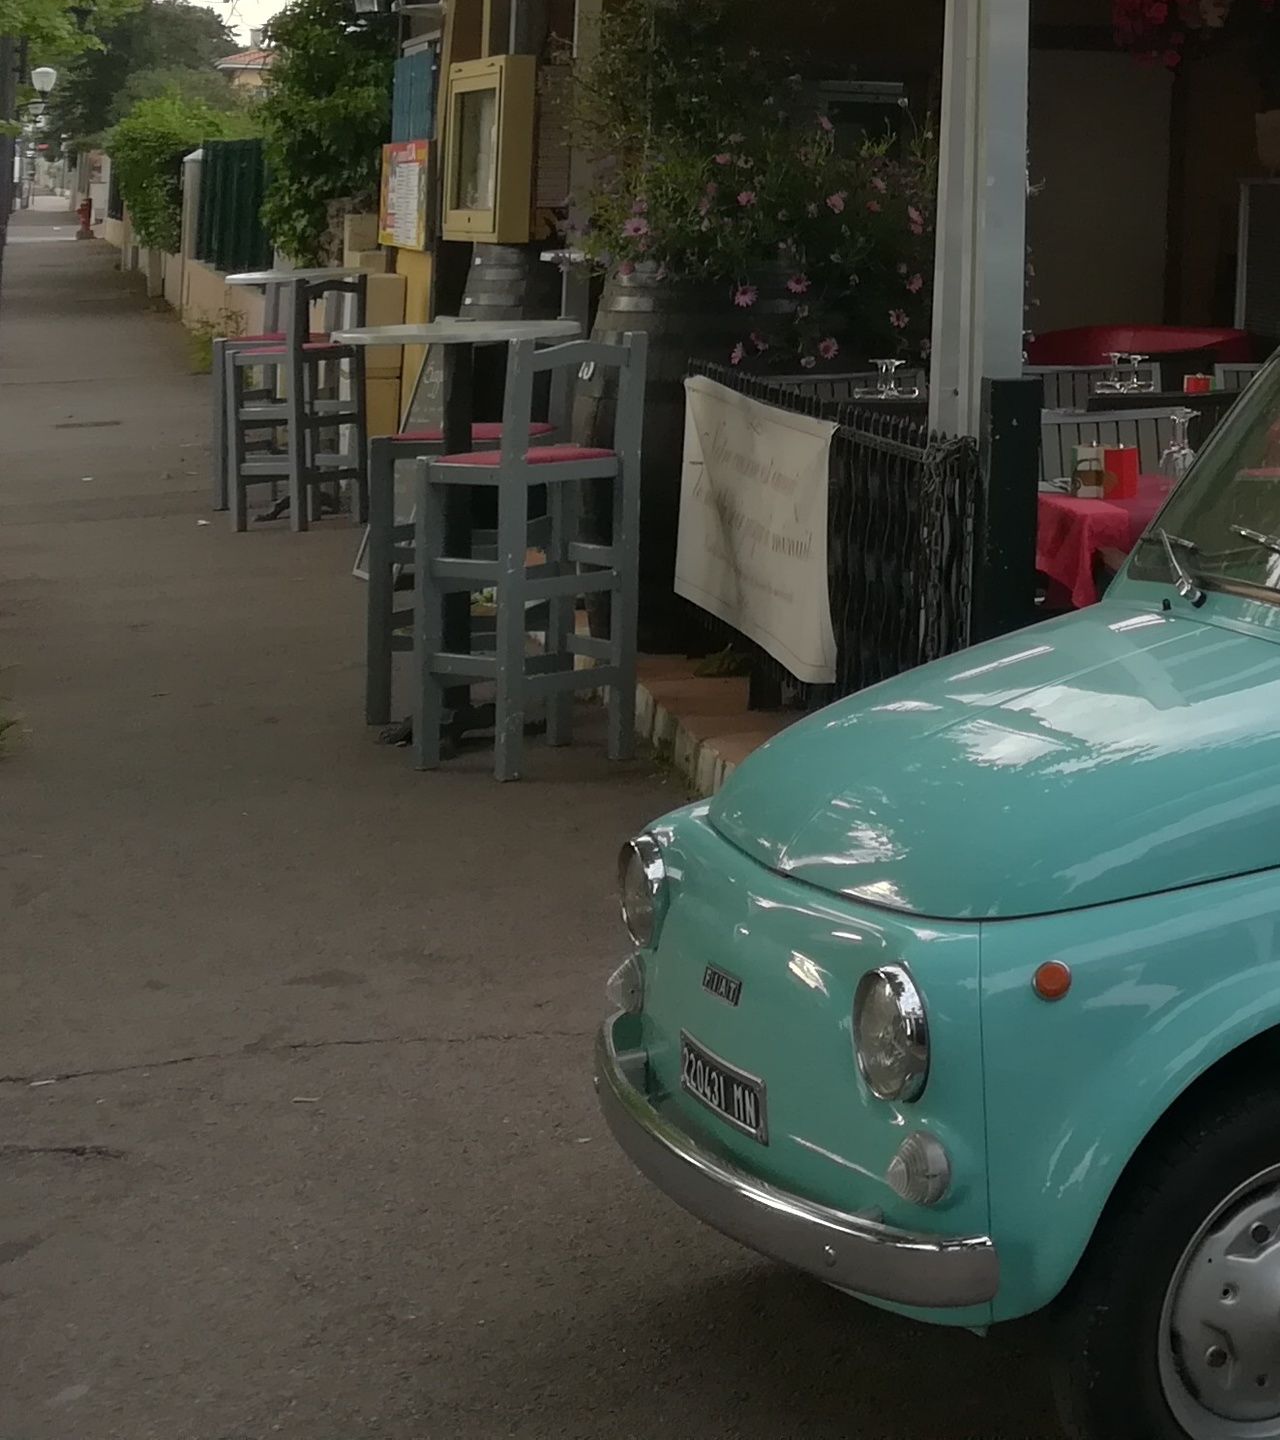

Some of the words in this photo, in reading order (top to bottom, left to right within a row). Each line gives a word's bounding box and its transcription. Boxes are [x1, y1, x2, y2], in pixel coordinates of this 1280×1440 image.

[704, 969, 737, 1003] FIAT
[682, 1046, 726, 1111] 220431
[732, 1084, 757, 1128] MN
